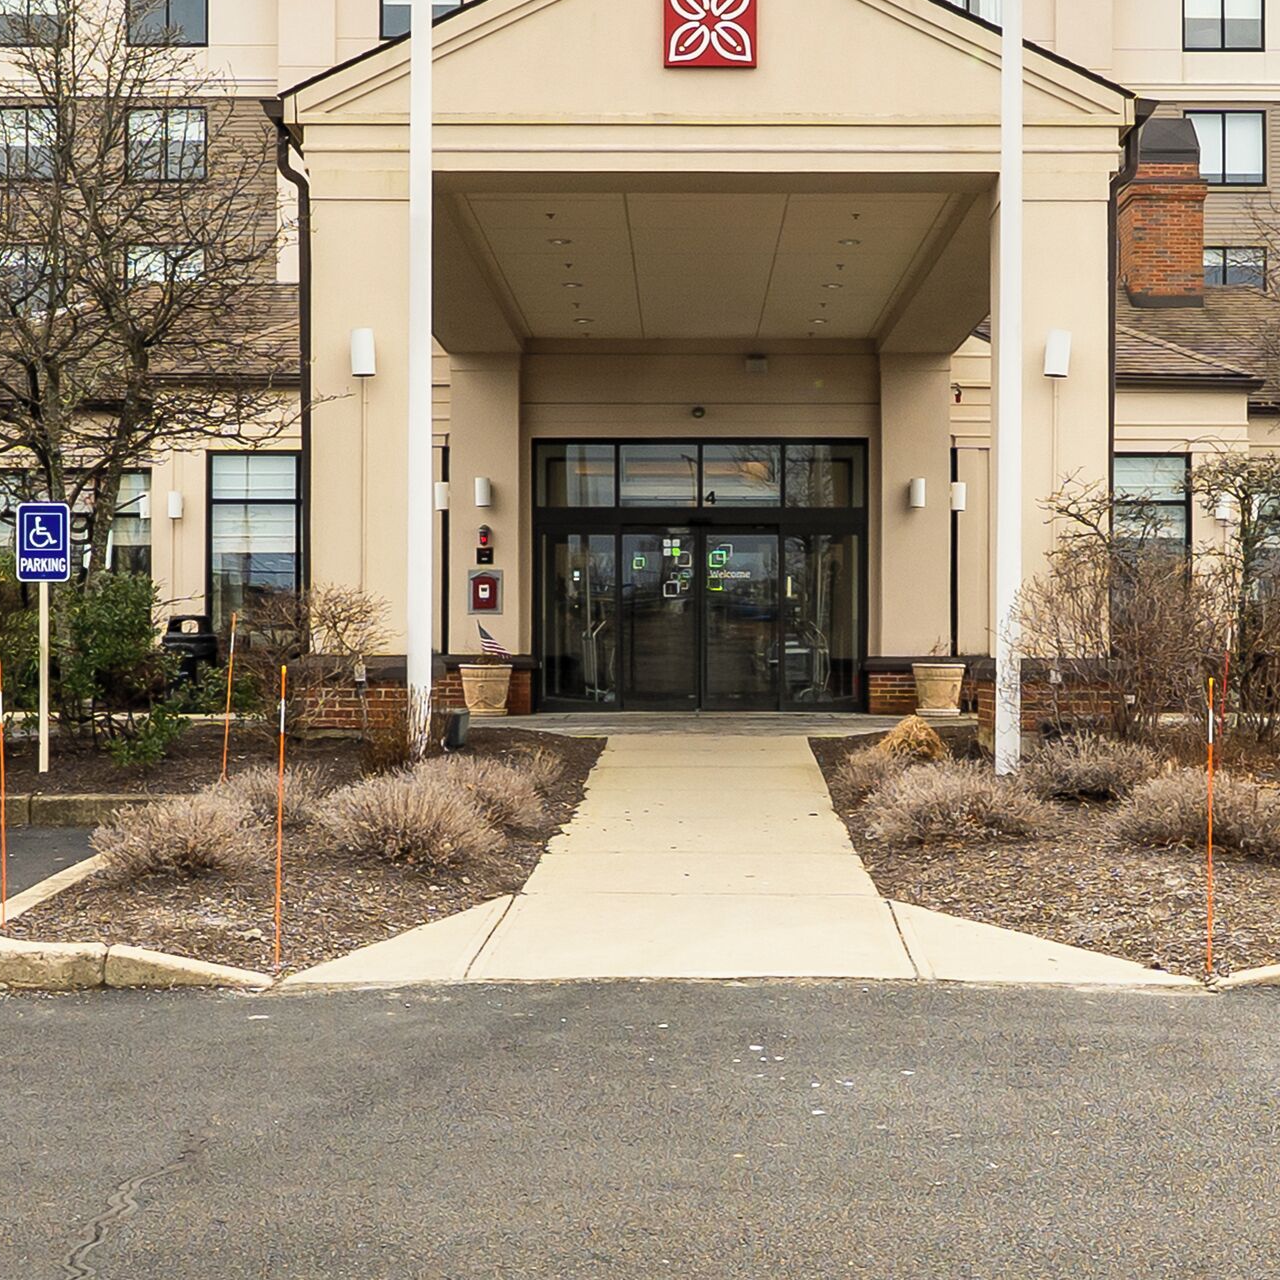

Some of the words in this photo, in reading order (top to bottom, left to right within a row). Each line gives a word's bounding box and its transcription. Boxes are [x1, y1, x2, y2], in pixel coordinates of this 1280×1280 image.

[705, 490, 717, 505] 4
[20, 557, 66, 572] PARKING
[709, 569, 751, 579] Welcome
